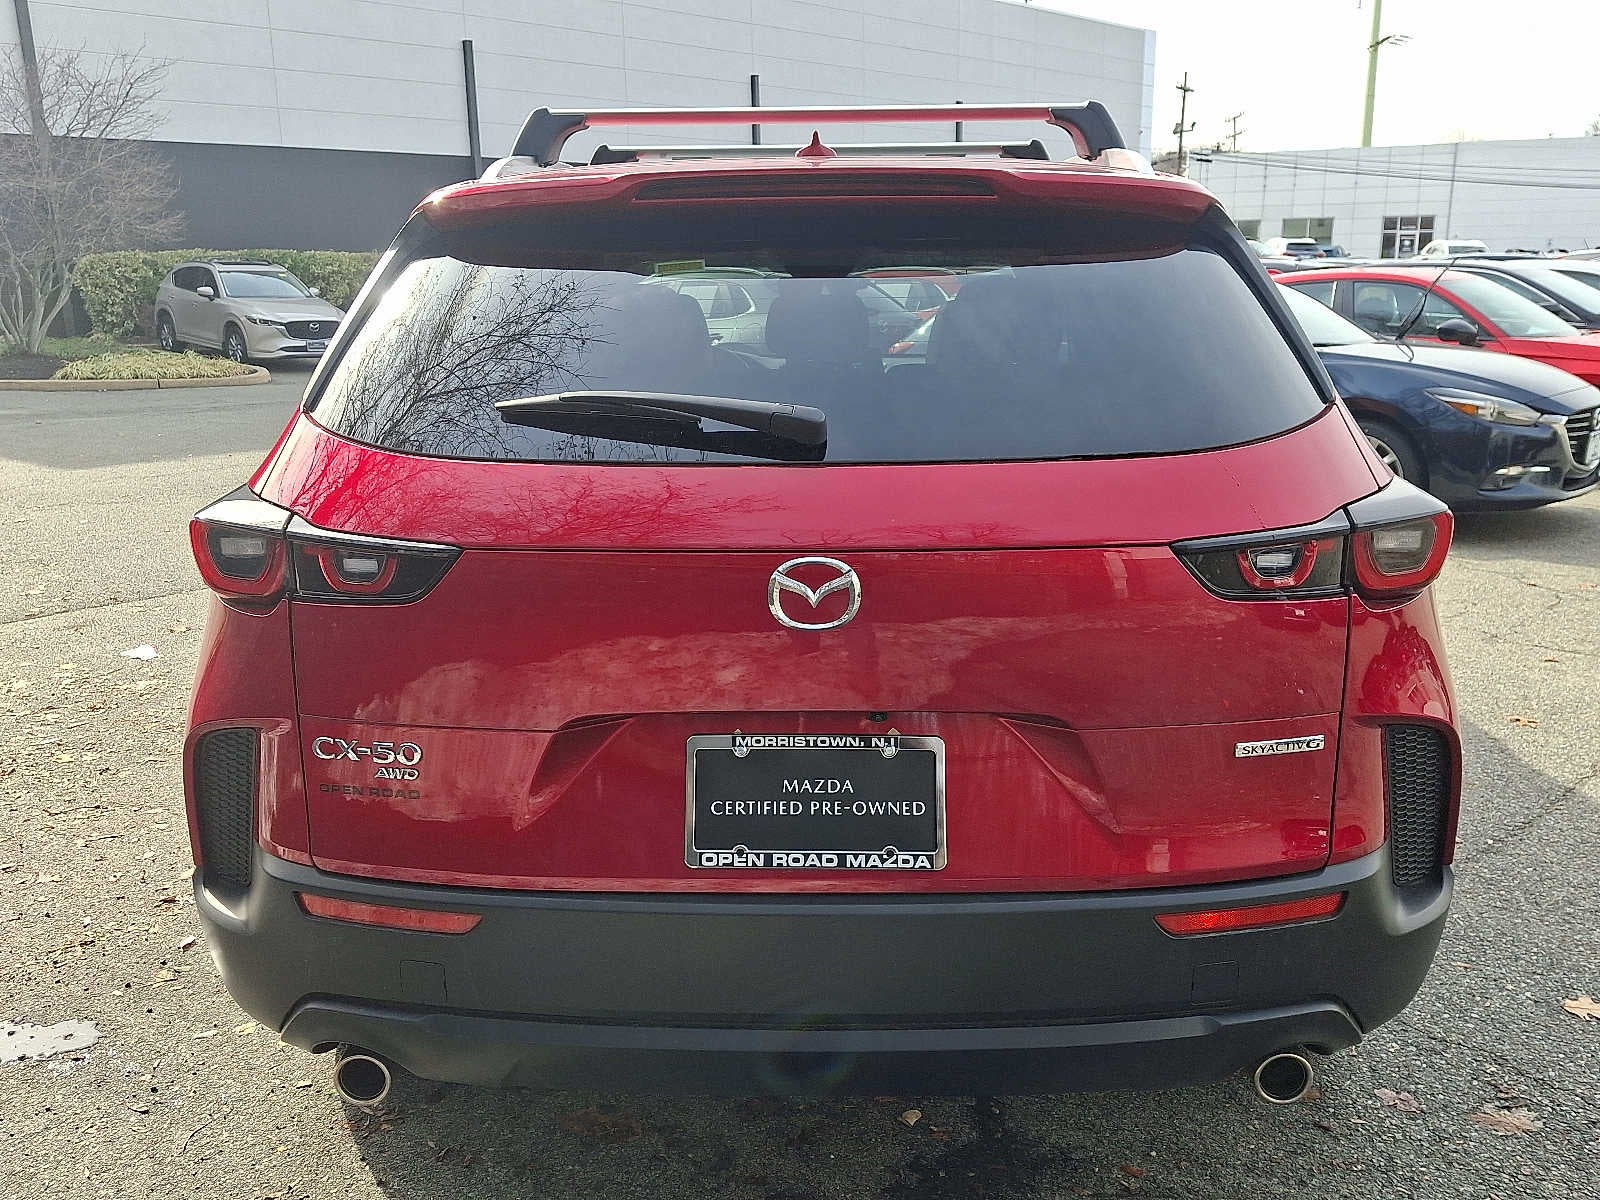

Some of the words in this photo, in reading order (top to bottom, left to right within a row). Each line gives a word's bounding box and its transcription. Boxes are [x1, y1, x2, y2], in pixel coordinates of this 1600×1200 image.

[735, 736, 864, 747] MORRISTOWN,
[312, 736, 422, 766] CX-50
[374, 767, 419, 780] AWD
[319, 783, 365, 795] OPEN
[369, 786, 420, 799] ROAD
[782, 779, 854, 794] MAZDA
[710, 801, 803, 816] CERTIFIED
[810, 801, 926, 817] PRE-OWNED
[701, 853, 765, 867] OPEN
[772, 854, 838, 868] ROAD
[846, 855, 932, 869] MAZDA
